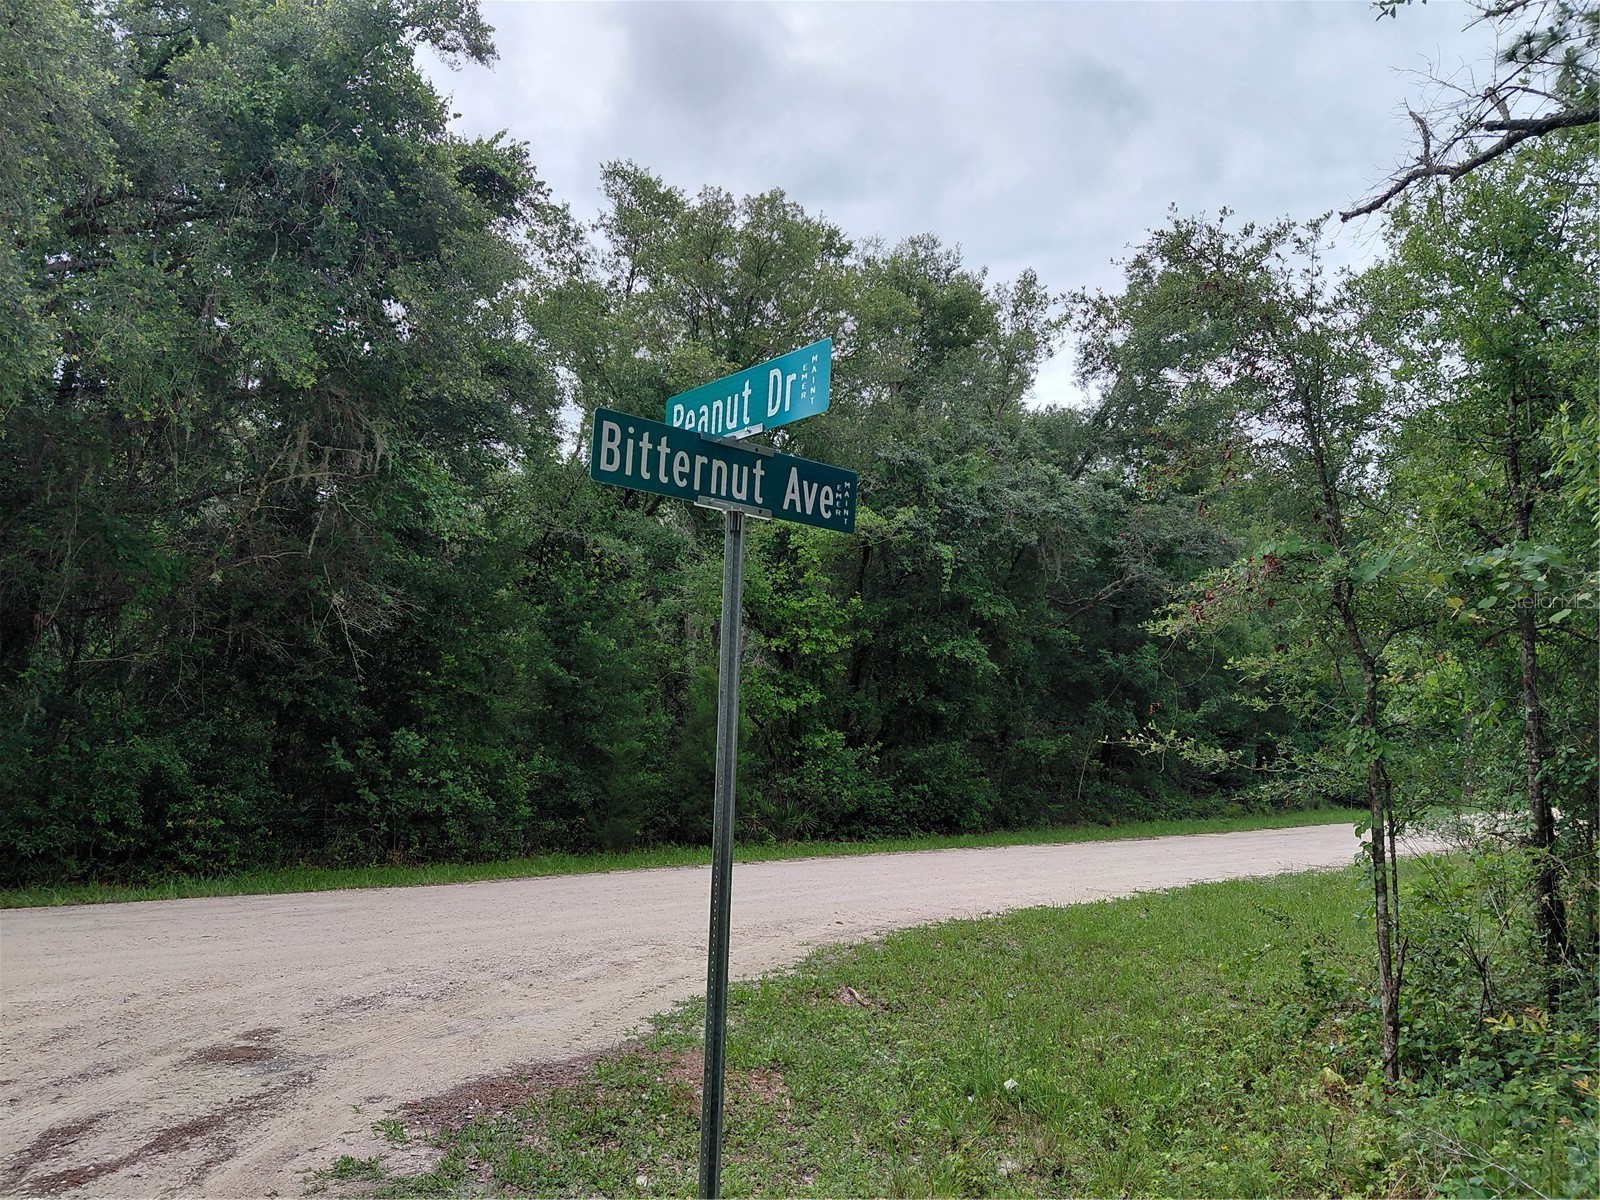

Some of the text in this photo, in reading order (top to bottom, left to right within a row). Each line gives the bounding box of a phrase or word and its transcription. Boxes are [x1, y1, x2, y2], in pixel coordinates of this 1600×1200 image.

[673, 368, 797, 434] Peanut Dr
[810, 354, 818, 405] MAINT
[600, 420, 834, 519] Bitternut Ave
[835, 484, 843, 516] EMER
[843, 481, 851, 525] MAINT
